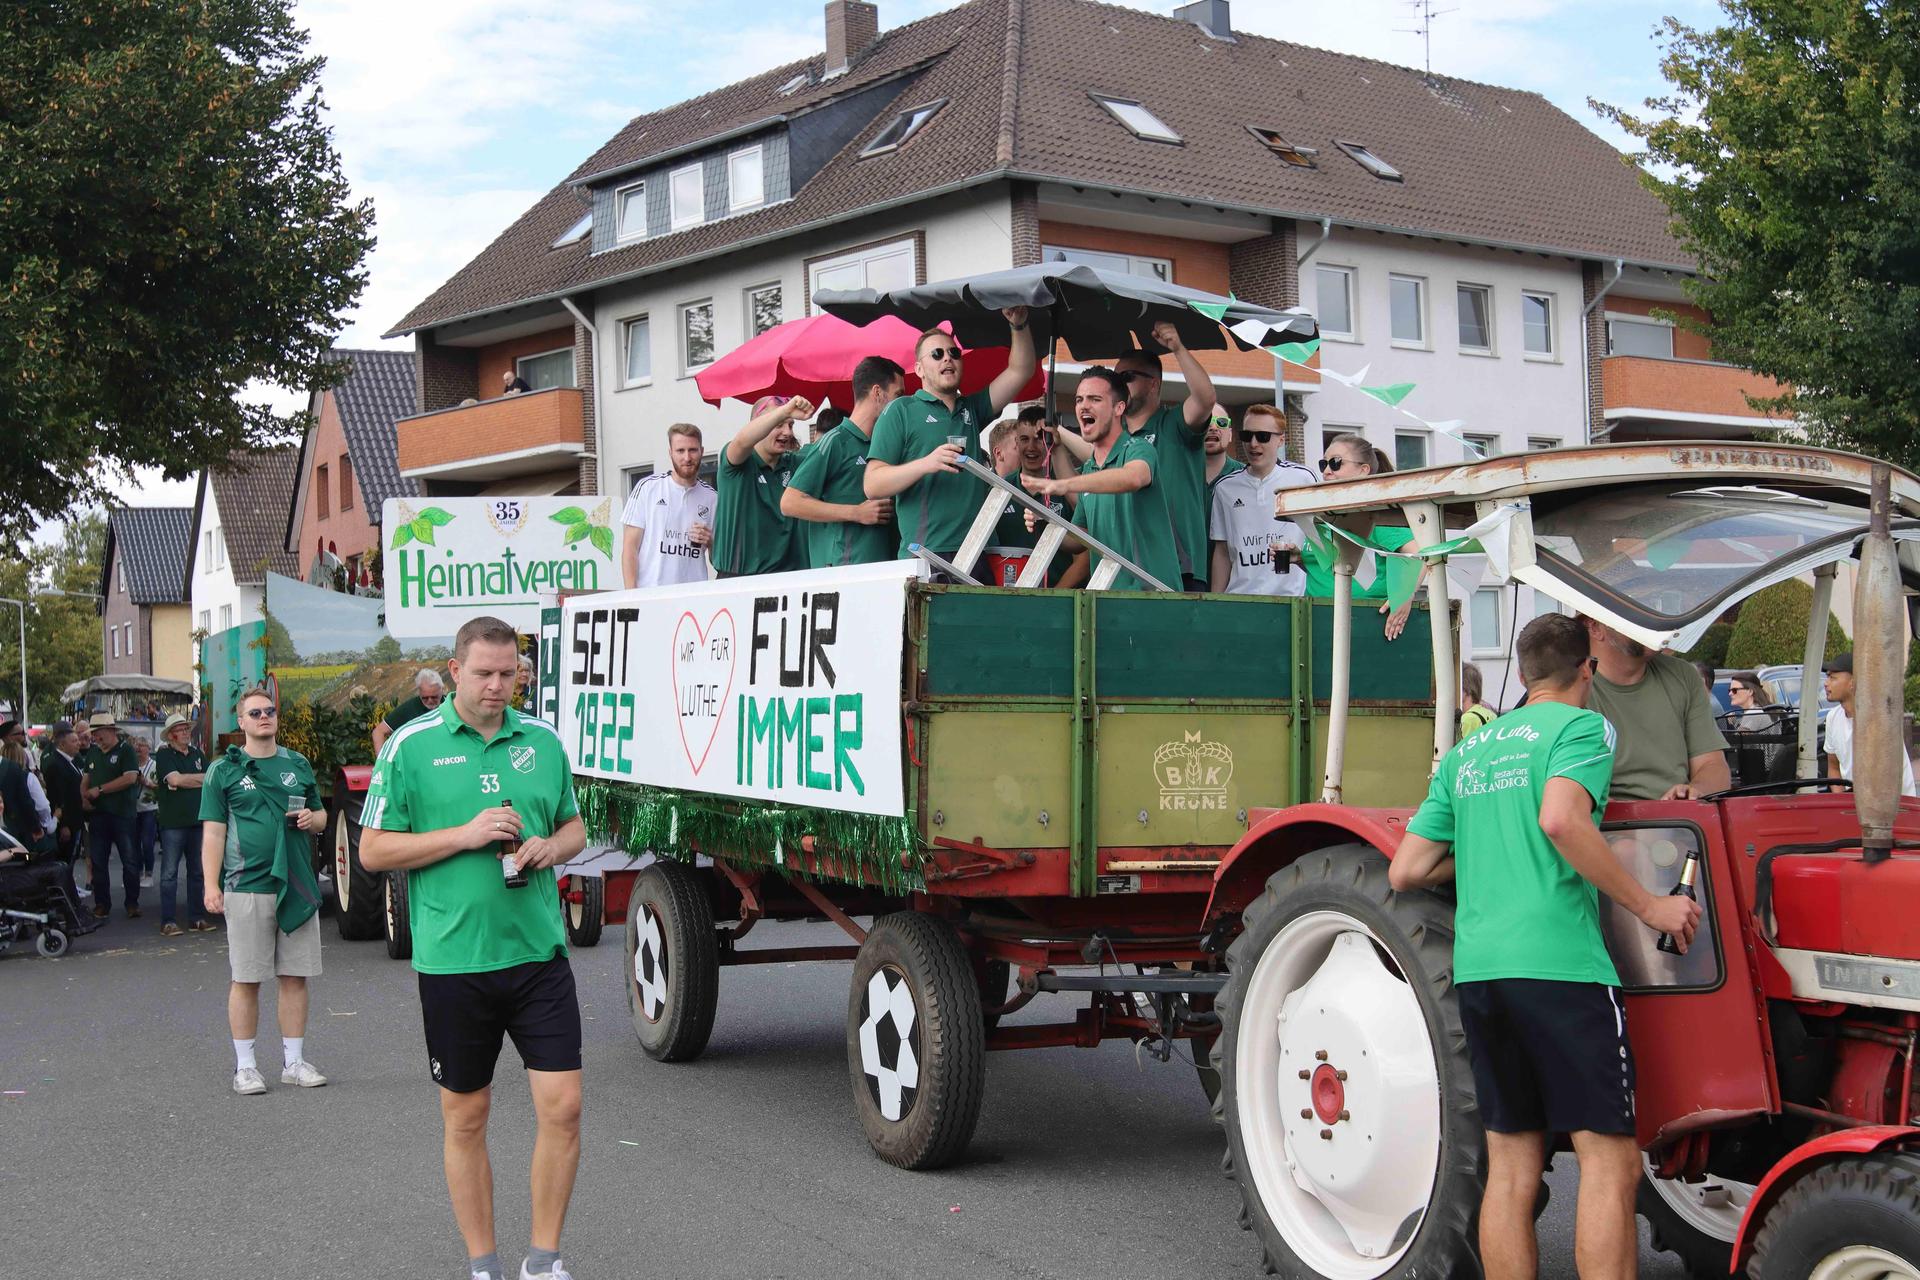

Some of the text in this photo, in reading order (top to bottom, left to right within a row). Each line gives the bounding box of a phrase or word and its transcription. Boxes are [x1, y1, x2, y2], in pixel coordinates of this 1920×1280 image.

[496, 502, 520, 521] 35
[665, 529, 681, 539] Wir
[1242, 535, 1263, 546] Wir
[660, 541, 700, 559] Luthe
[399, 544, 598, 608] Heimatverein
[571, 608, 640, 687] SEIT
[680, 637, 730, 663] WIR FÜR
[750, 592, 841, 689] FÜR
[681, 684, 719, 718] LUTHE
[574, 692, 636, 775] 1922
[1184, 729, 1201, 743] M
[1457, 724, 1541, 758] TSV Luthe
[736, 692, 866, 796] IMMER
[432, 754, 467, 767] avacon
[480, 773, 500, 794] 33
[1165, 766, 1222, 786] B K
[243, 783, 256, 791] MK
[1159, 795, 1227, 810] KRONE
